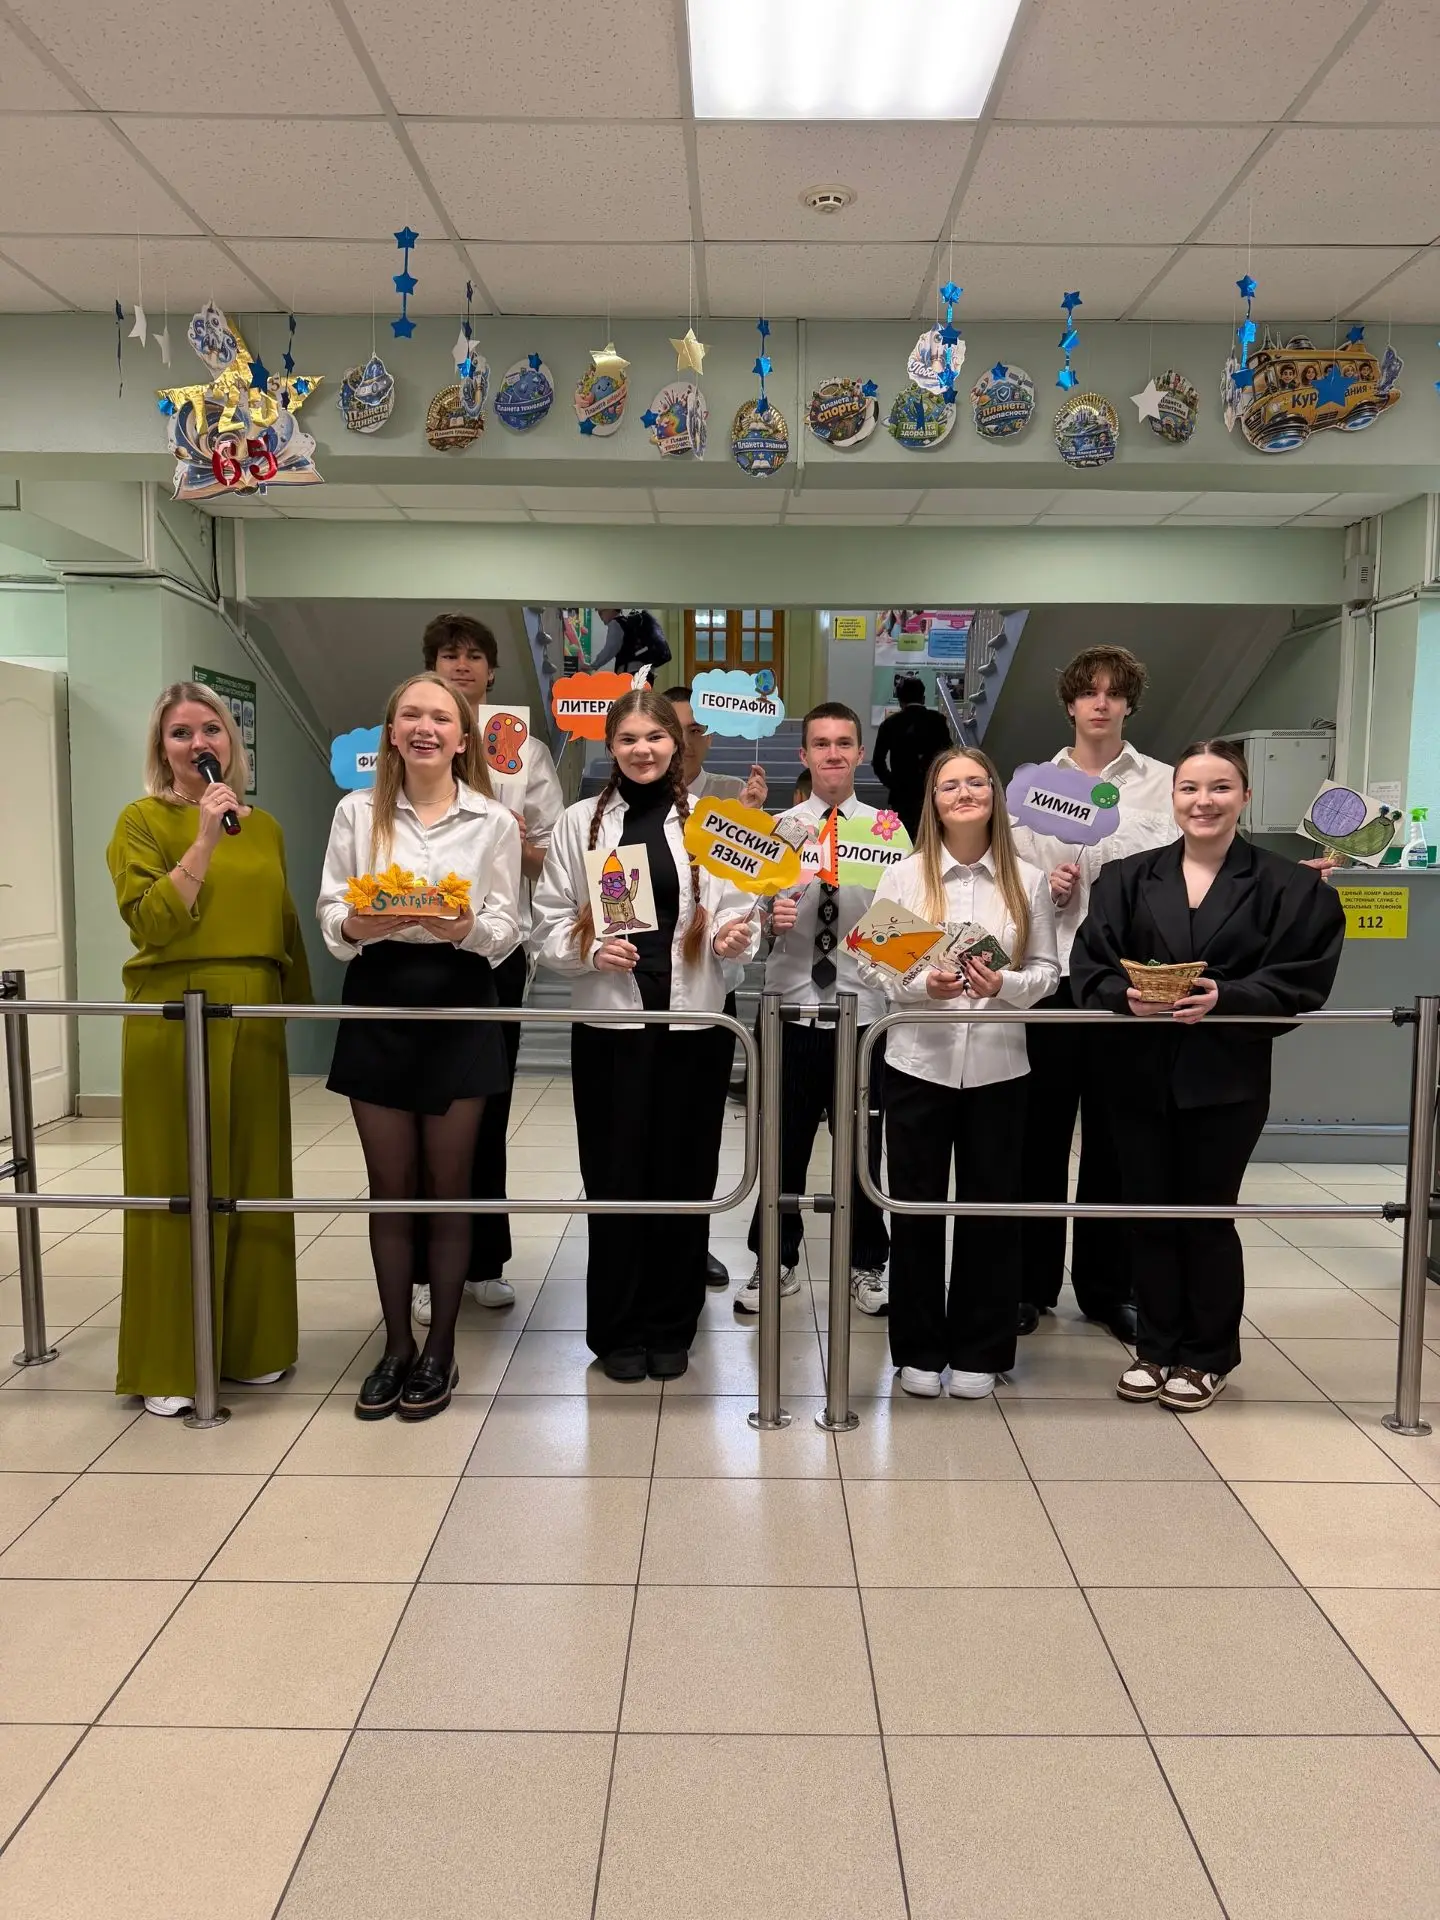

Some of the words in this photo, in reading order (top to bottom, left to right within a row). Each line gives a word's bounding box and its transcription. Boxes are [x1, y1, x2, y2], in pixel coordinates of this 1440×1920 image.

[819, 396, 850, 411] Планета
[1291, 392, 1317, 408] Кур
[1344, 384, 1368, 397] ания
[347, 405, 389, 422] Планета
[497, 403, 520, 413] Планета
[817, 402, 860, 423] спорта
[981, 410, 1029, 423] безопасности
[982, 403, 1027, 416] Планета
[347, 413, 389, 430] единства
[902, 423, 936, 431] Плата
[737, 441, 763, 449] Планета
[764, 441, 787, 449] знаний
[212, 433, 278, 486] 65
[559, 700, 615, 713] ЛИТЕРА
[702, 693, 777, 715] ГЕОГРАФИЯ
[358, 755, 377, 767] ФИ
[1031, 791, 1091, 820] ХИМИЯ
[705, 814, 781, 860] РУССКИЙ
[711, 843, 758, 874] ЯЗЫК
[838, 844, 902, 865] ОЛОГИЯ
[371, 889, 392, 912] 5
[1358, 916, 1384, 929] 112
